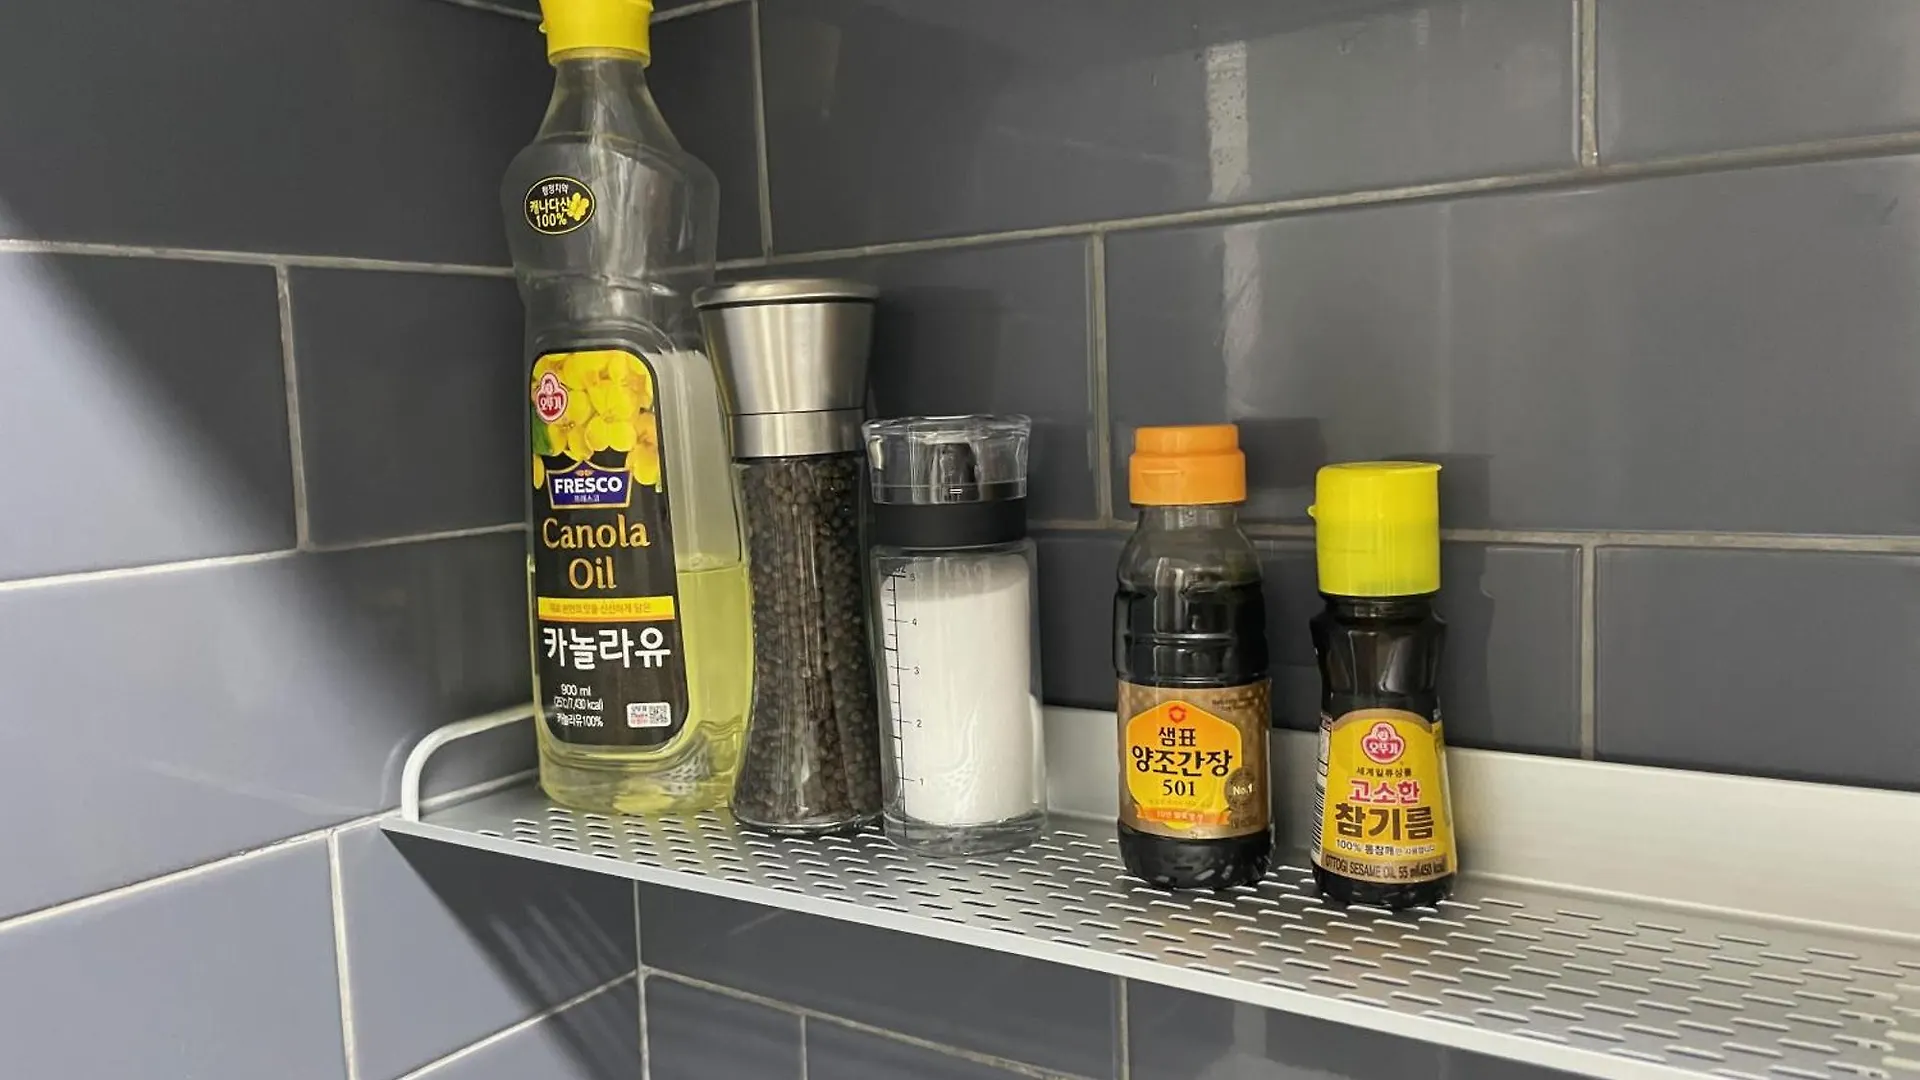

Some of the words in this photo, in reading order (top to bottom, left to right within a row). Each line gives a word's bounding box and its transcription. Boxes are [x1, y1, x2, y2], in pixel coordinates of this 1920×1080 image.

[530, 196, 571, 215] 캐나다산
[536, 212, 568, 228] 100%
[554, 476, 623, 494] FRESCO
[542, 513, 651, 549] Canola
[568, 555, 617, 590] Oil
[542, 626, 672, 671] 카놀라유
[914, 666, 920, 675] 3
[560, 683, 578, 696] 900
[579, 685, 592, 697] ml
[916, 719, 923, 728] 2
[1158, 726, 1197, 747] 샘표
[1368, 741, 1399, 755] 오뚜기
[1132, 745, 1233, 777] 양조간장
[1163, 779, 1195, 796] 501
[1349, 779, 1421, 804] 고소한
[1335, 802, 1435, 841] 참기름
[1336, 839, 1361, 853] 100%
[1326, 853, 1348, 874] OTTOGI
[1350, 861, 1382, 878] SESAME
[1383, 866, 1397, 879] OIL
[1399, 866, 1409, 879] 55
